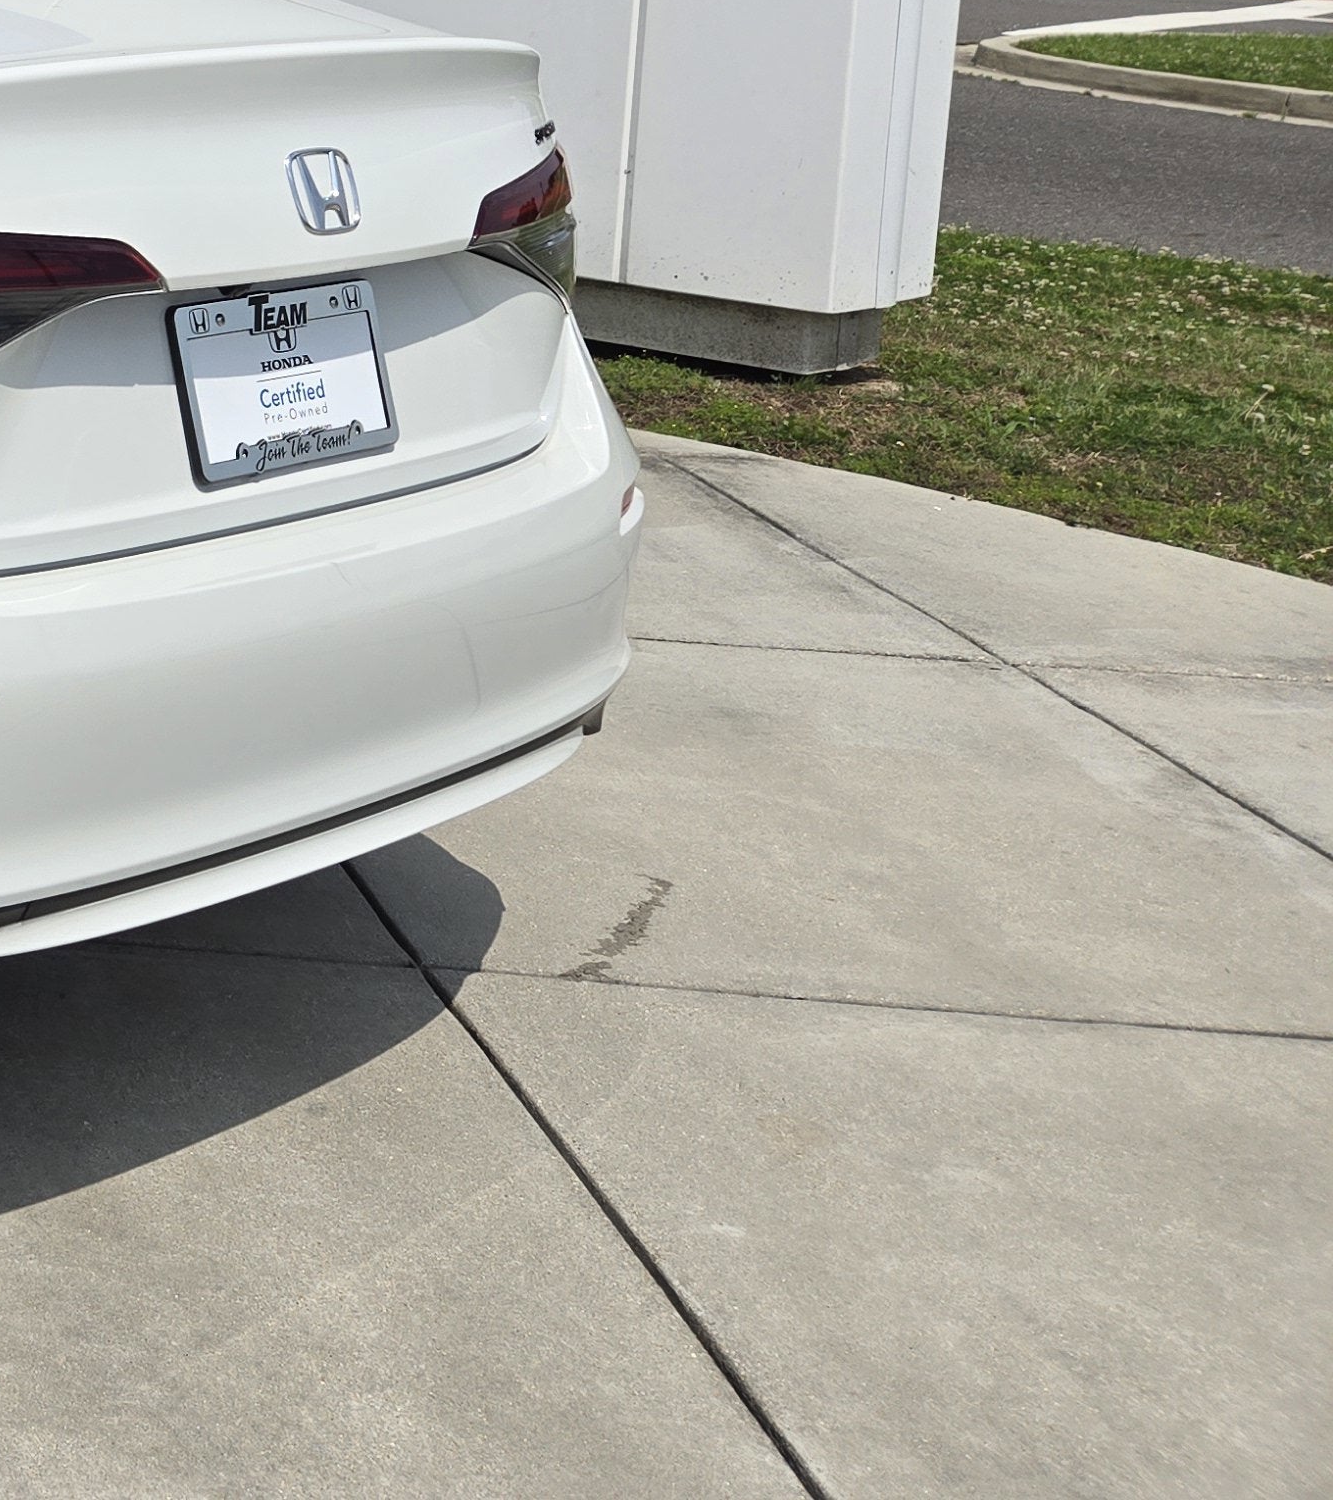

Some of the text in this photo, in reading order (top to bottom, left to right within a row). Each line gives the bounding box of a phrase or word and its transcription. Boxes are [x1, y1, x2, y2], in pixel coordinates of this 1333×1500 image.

[248, 293, 308, 333] TEAM
[260, 355, 314, 373] HONDA
[259, 378, 326, 409] Certified
[263, 403, 329, 424] Pre-Owned
[255, 439, 287, 471] Join
[286, 431, 312, 458] The
[311, 426, 352, 453] Team!
